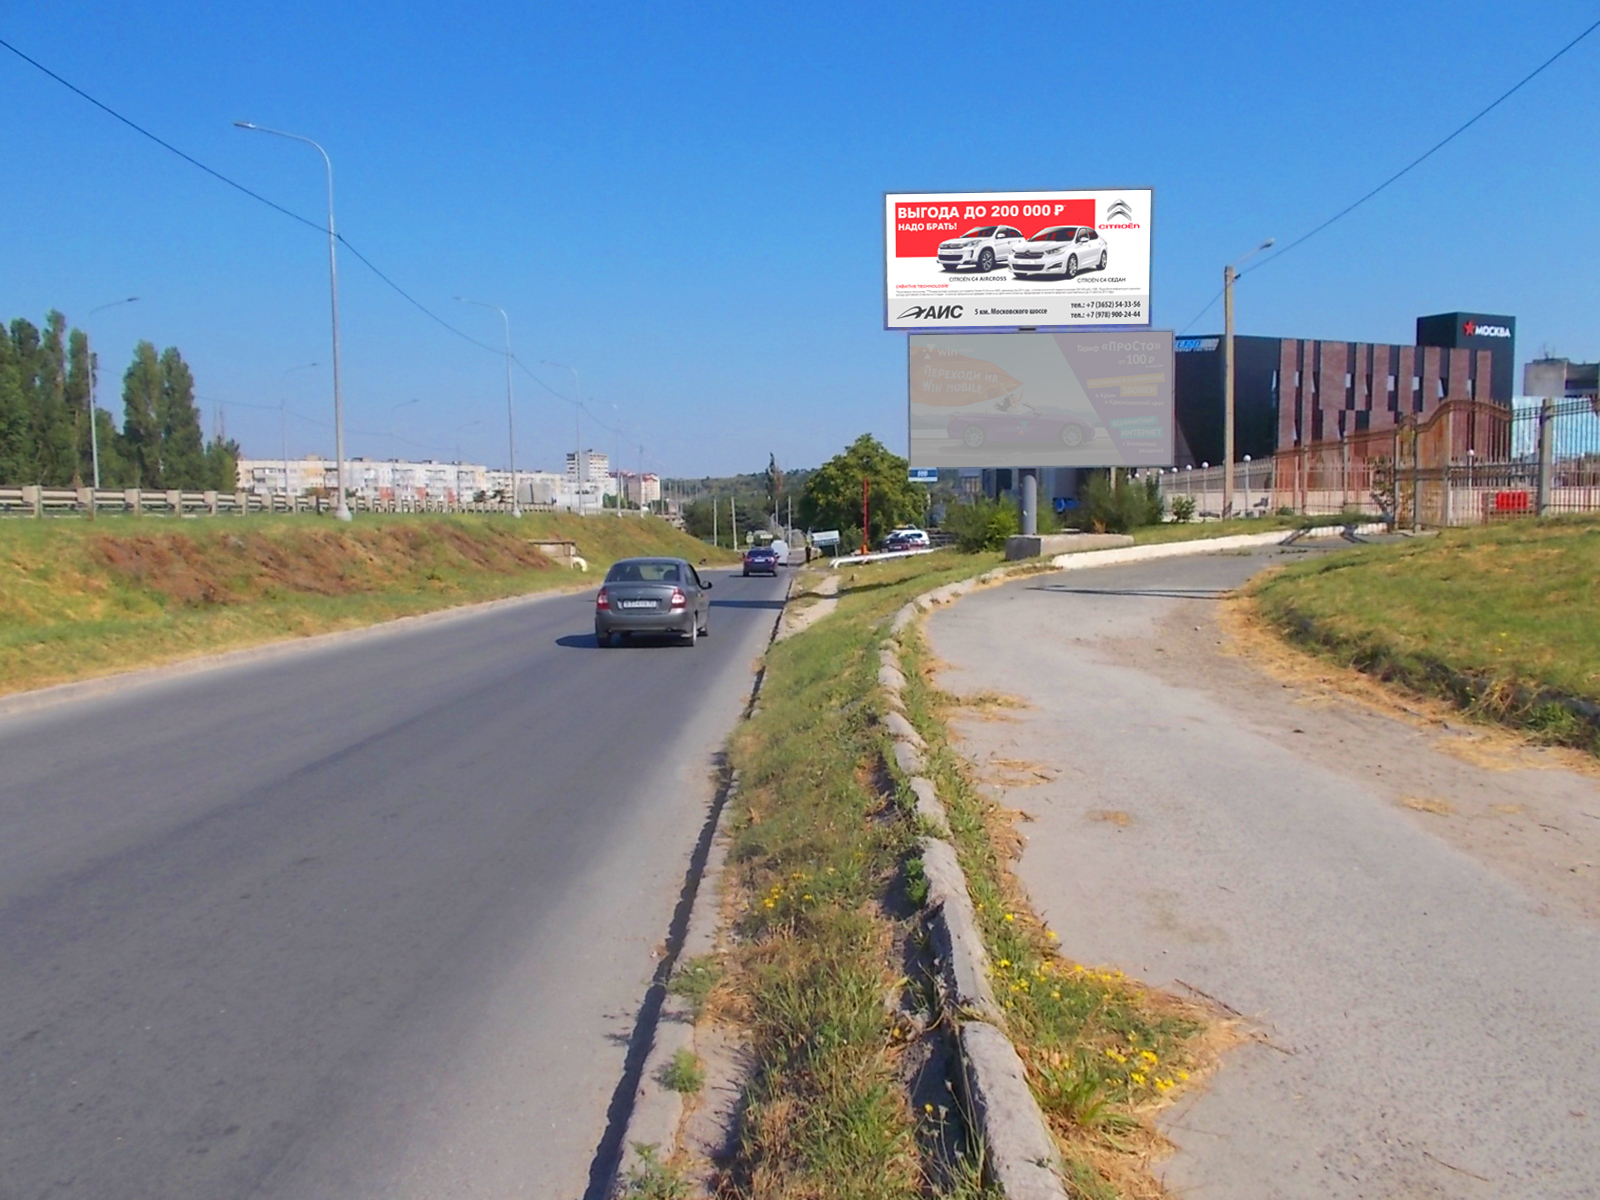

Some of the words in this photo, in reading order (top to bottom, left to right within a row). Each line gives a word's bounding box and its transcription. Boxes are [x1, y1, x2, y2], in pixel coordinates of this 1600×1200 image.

[898, 206, 960, 220] ВЫГОДА
[964, 206, 986, 219] ДО
[991, 205, 1019, 217] 200
[1023, 204, 1050, 216] 000
[898, 223, 924, 232] НАДО
[926, 222, 957, 230] БРАТЬ!
[924, 305, 964, 319] АИС
[1475, 326, 1511, 338] МОСКВА
[1126, 354, 1147, 364] 100
